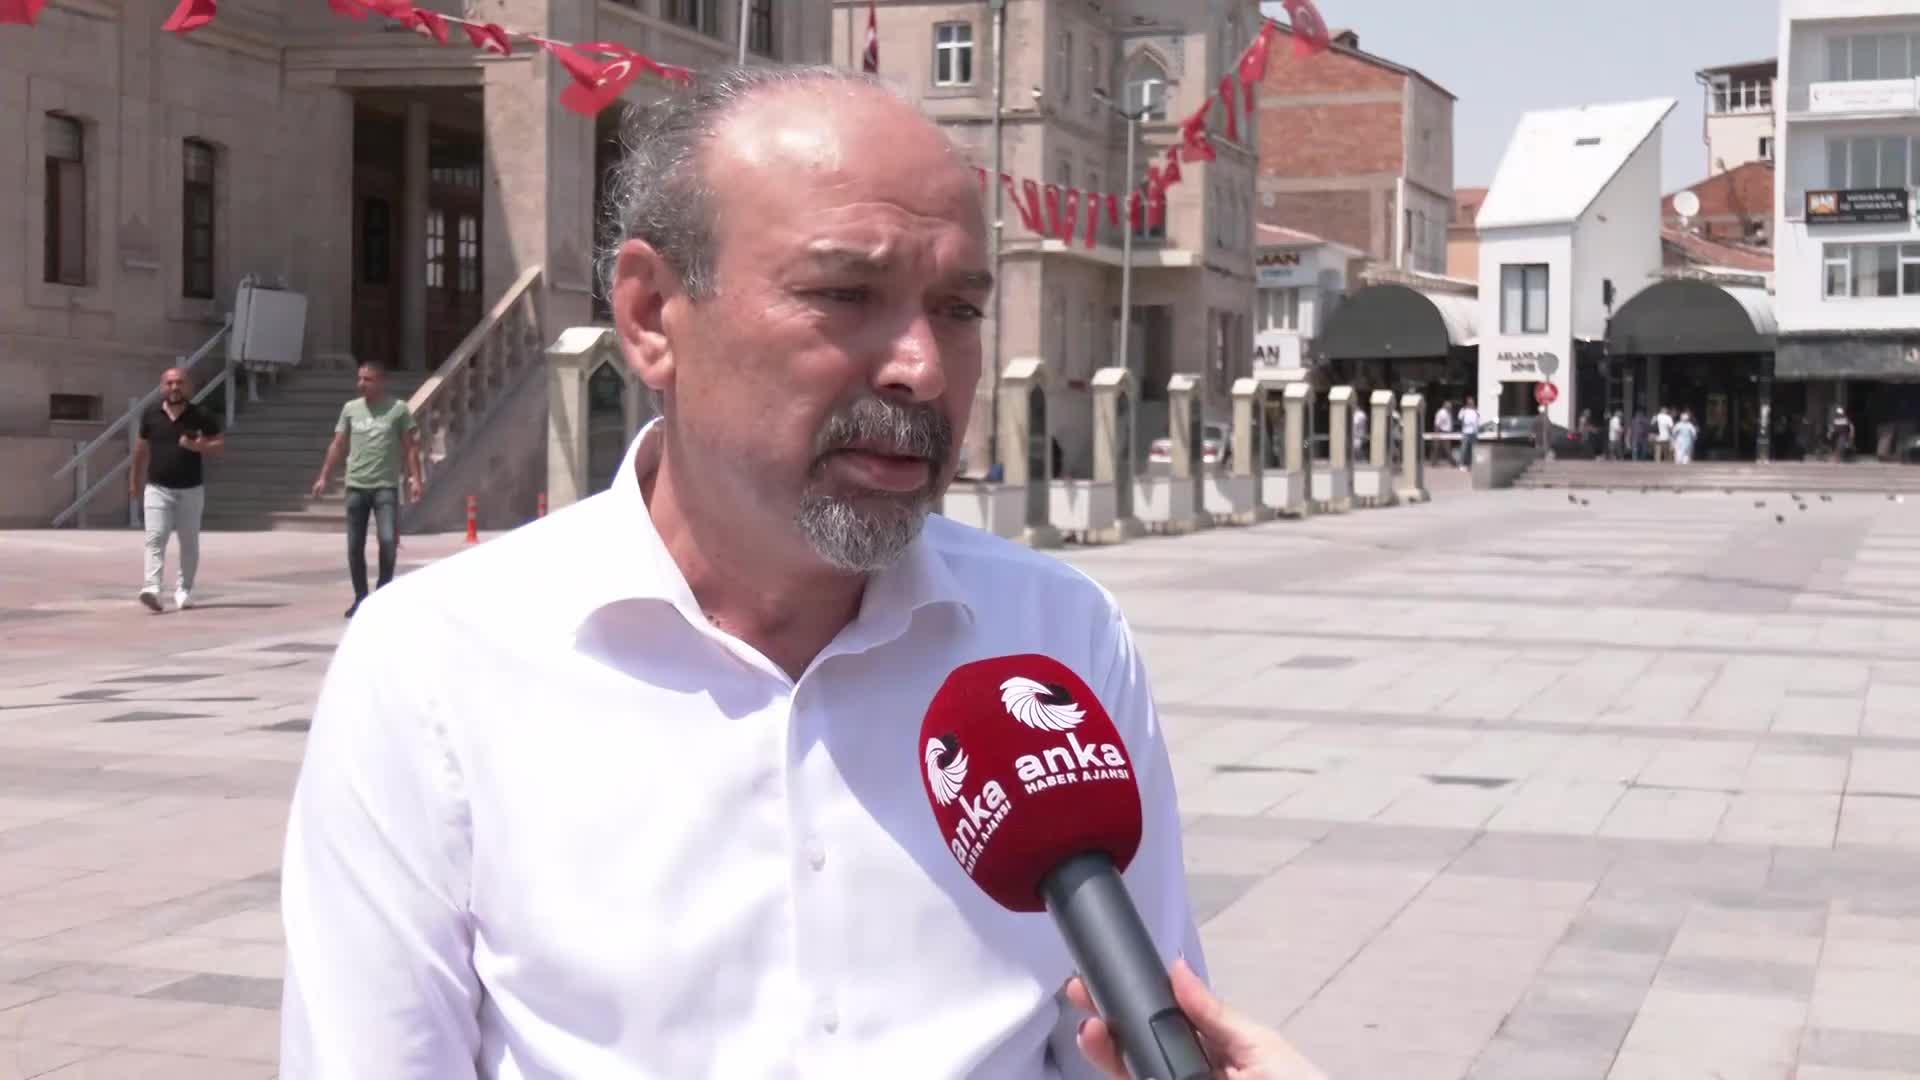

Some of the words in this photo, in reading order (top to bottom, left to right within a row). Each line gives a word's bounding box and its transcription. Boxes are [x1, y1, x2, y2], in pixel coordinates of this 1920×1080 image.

[1015, 732, 1126, 781] anka
[1024, 772, 1077, 794] HABER
[1082, 769, 1129, 781] AJANSI
[952, 780, 1007, 865] anka
[980, 799, 1012, 844] AJANSI
